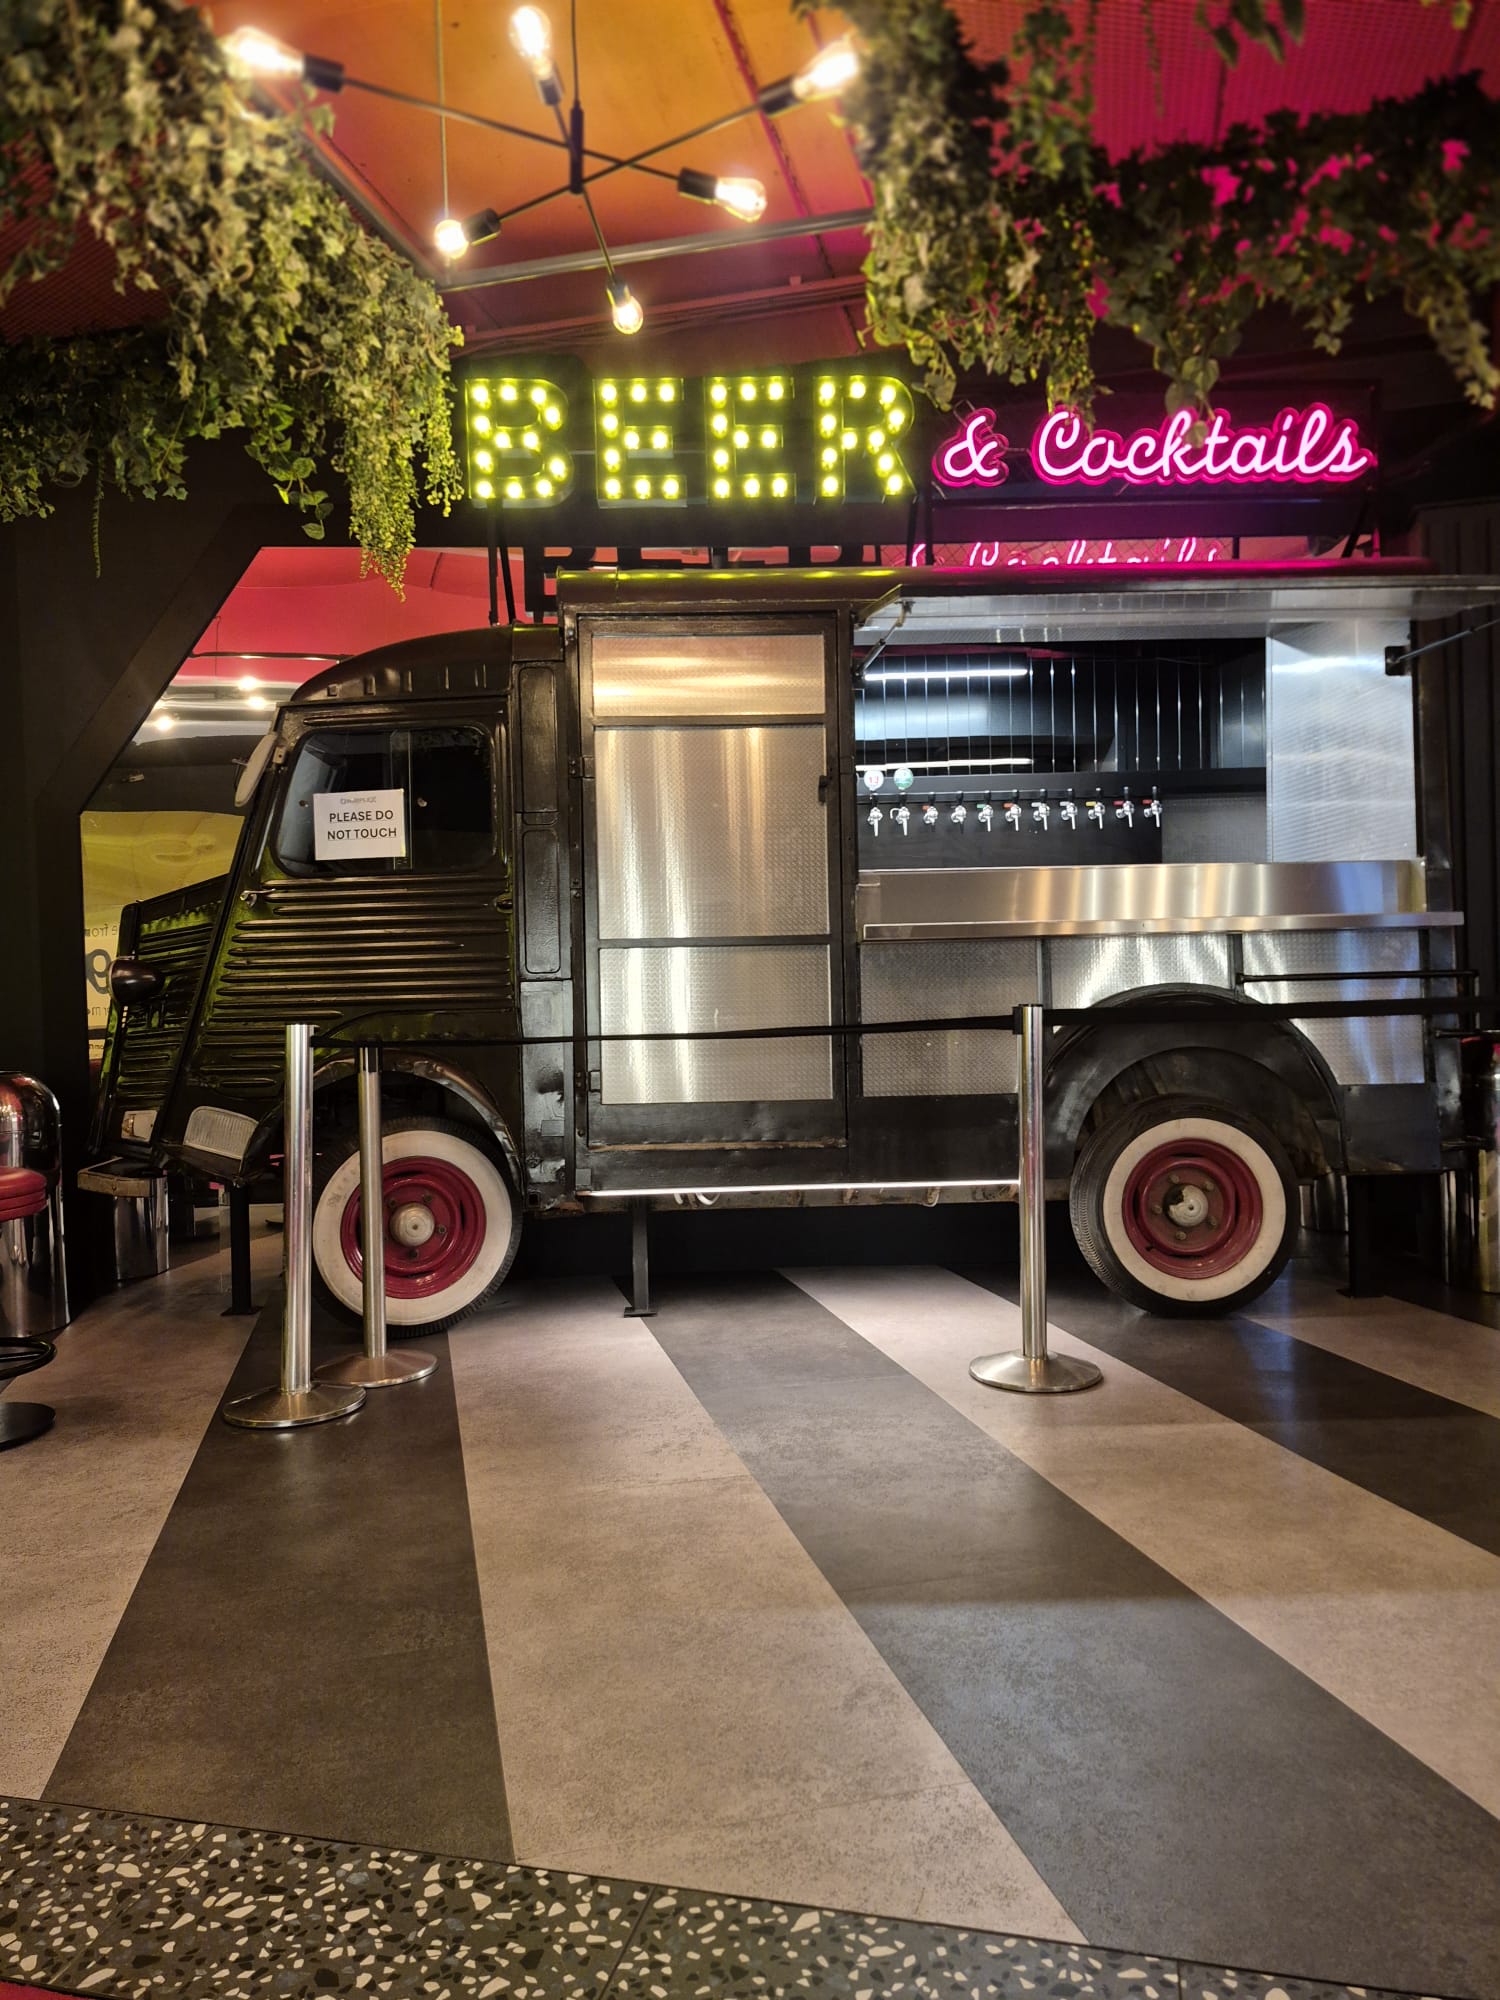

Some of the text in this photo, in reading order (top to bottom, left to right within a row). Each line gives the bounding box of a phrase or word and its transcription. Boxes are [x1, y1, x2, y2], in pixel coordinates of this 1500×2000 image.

[465, 376, 1370, 506] BEER & Cocktails
[329, 810, 393, 822] PLEASE DO
[327, 828, 397, 840] NOT TOUCH
